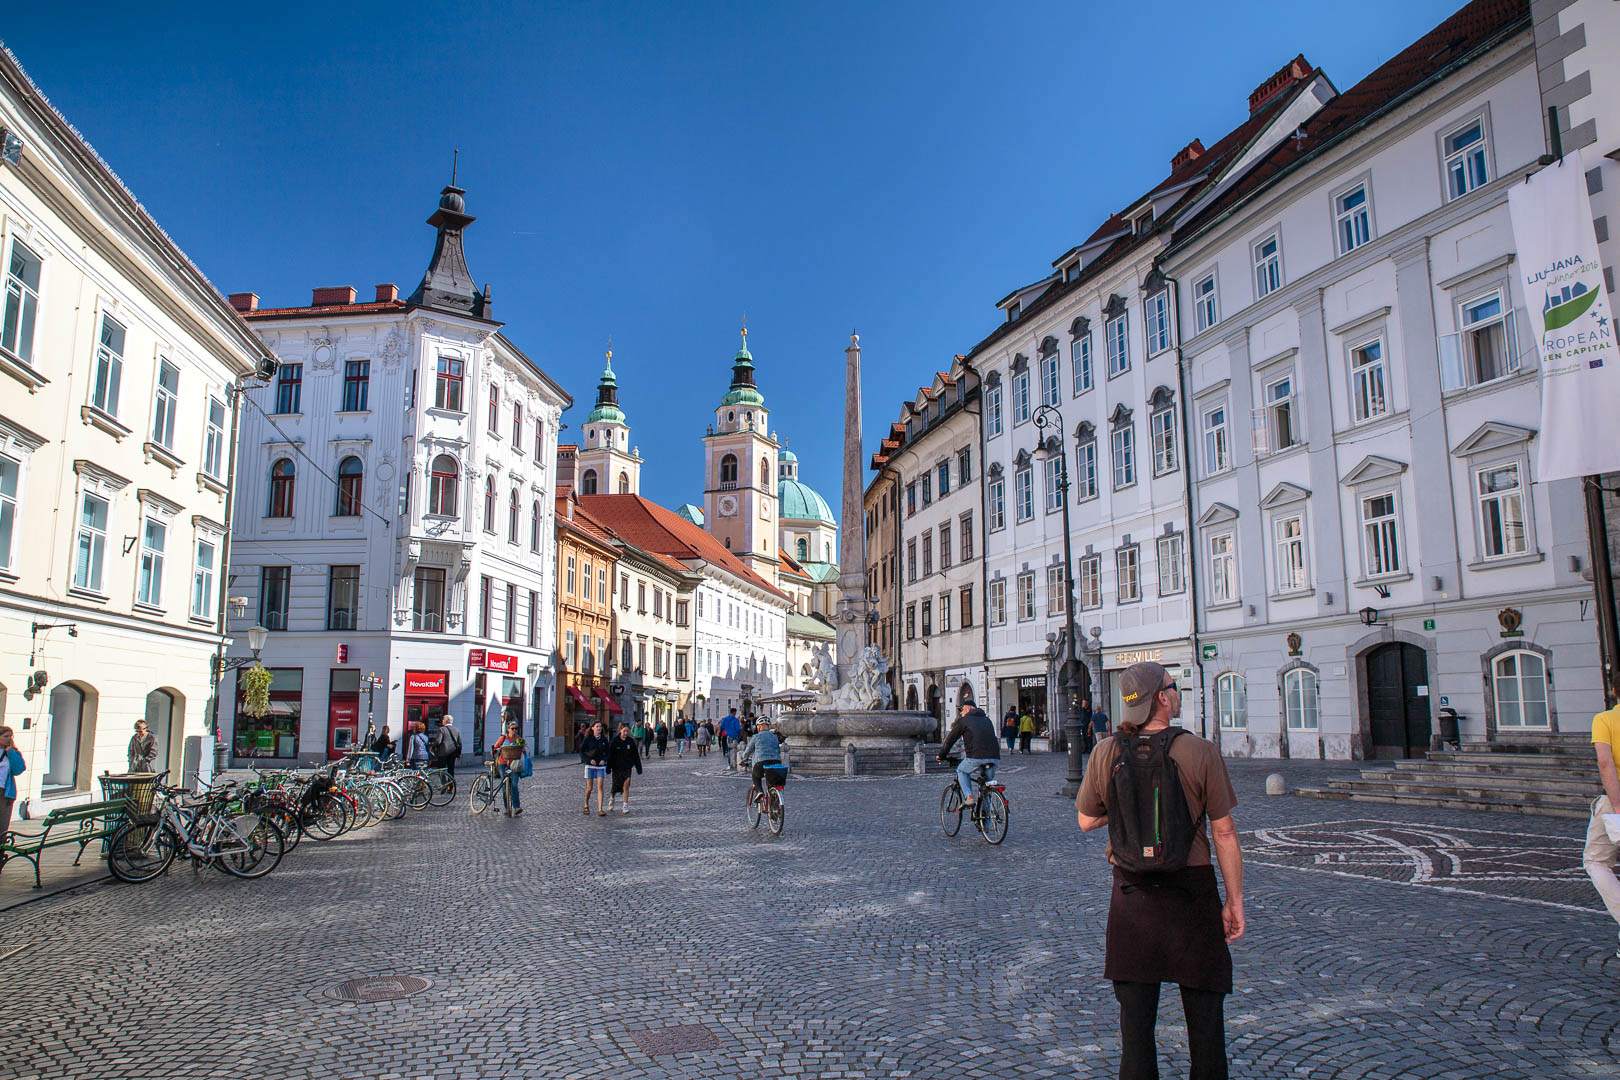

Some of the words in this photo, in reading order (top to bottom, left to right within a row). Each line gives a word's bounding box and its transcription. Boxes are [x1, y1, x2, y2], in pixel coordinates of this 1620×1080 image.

[1581, 260, 1599, 273] 2016
[1546, 327, 1610, 351] ROPEAN
[1566, 341, 1612, 358] CAPITAL
[409, 680, 440, 688] NovaKBM
[1021, 677, 1038, 688] LUSH
